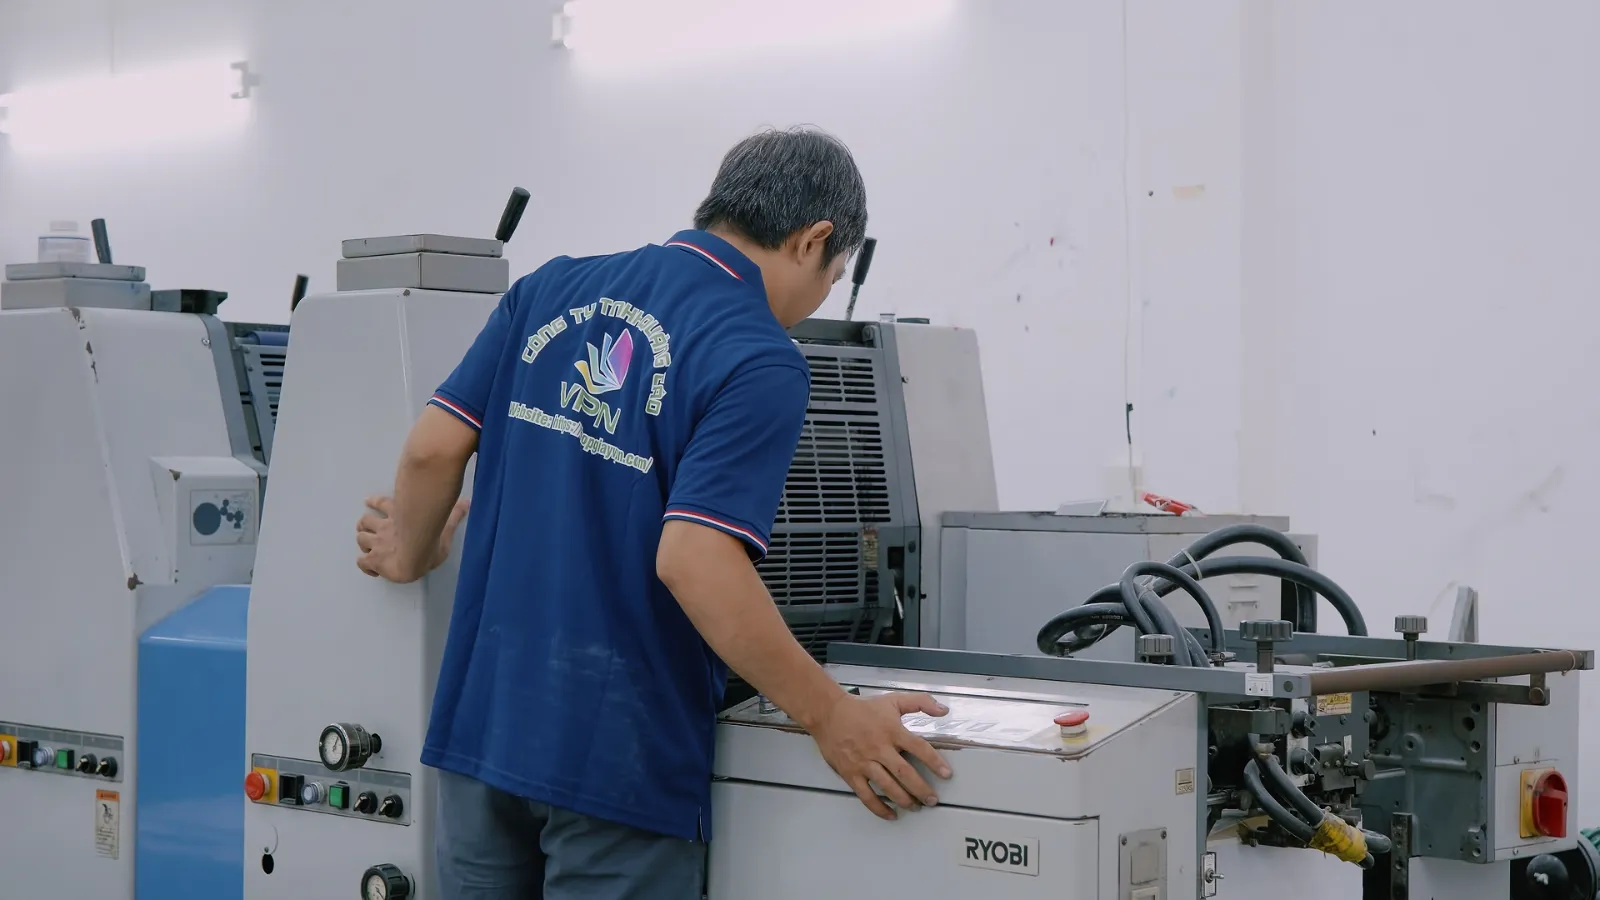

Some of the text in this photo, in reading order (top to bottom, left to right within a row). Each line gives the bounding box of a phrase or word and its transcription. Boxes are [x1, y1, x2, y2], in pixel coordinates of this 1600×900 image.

[521, 315, 568, 364] CÔNG
[569, 302, 598, 325] TY
[560, 381, 621, 435] VPN
[965, 837, 1028, 867] RYOBI
